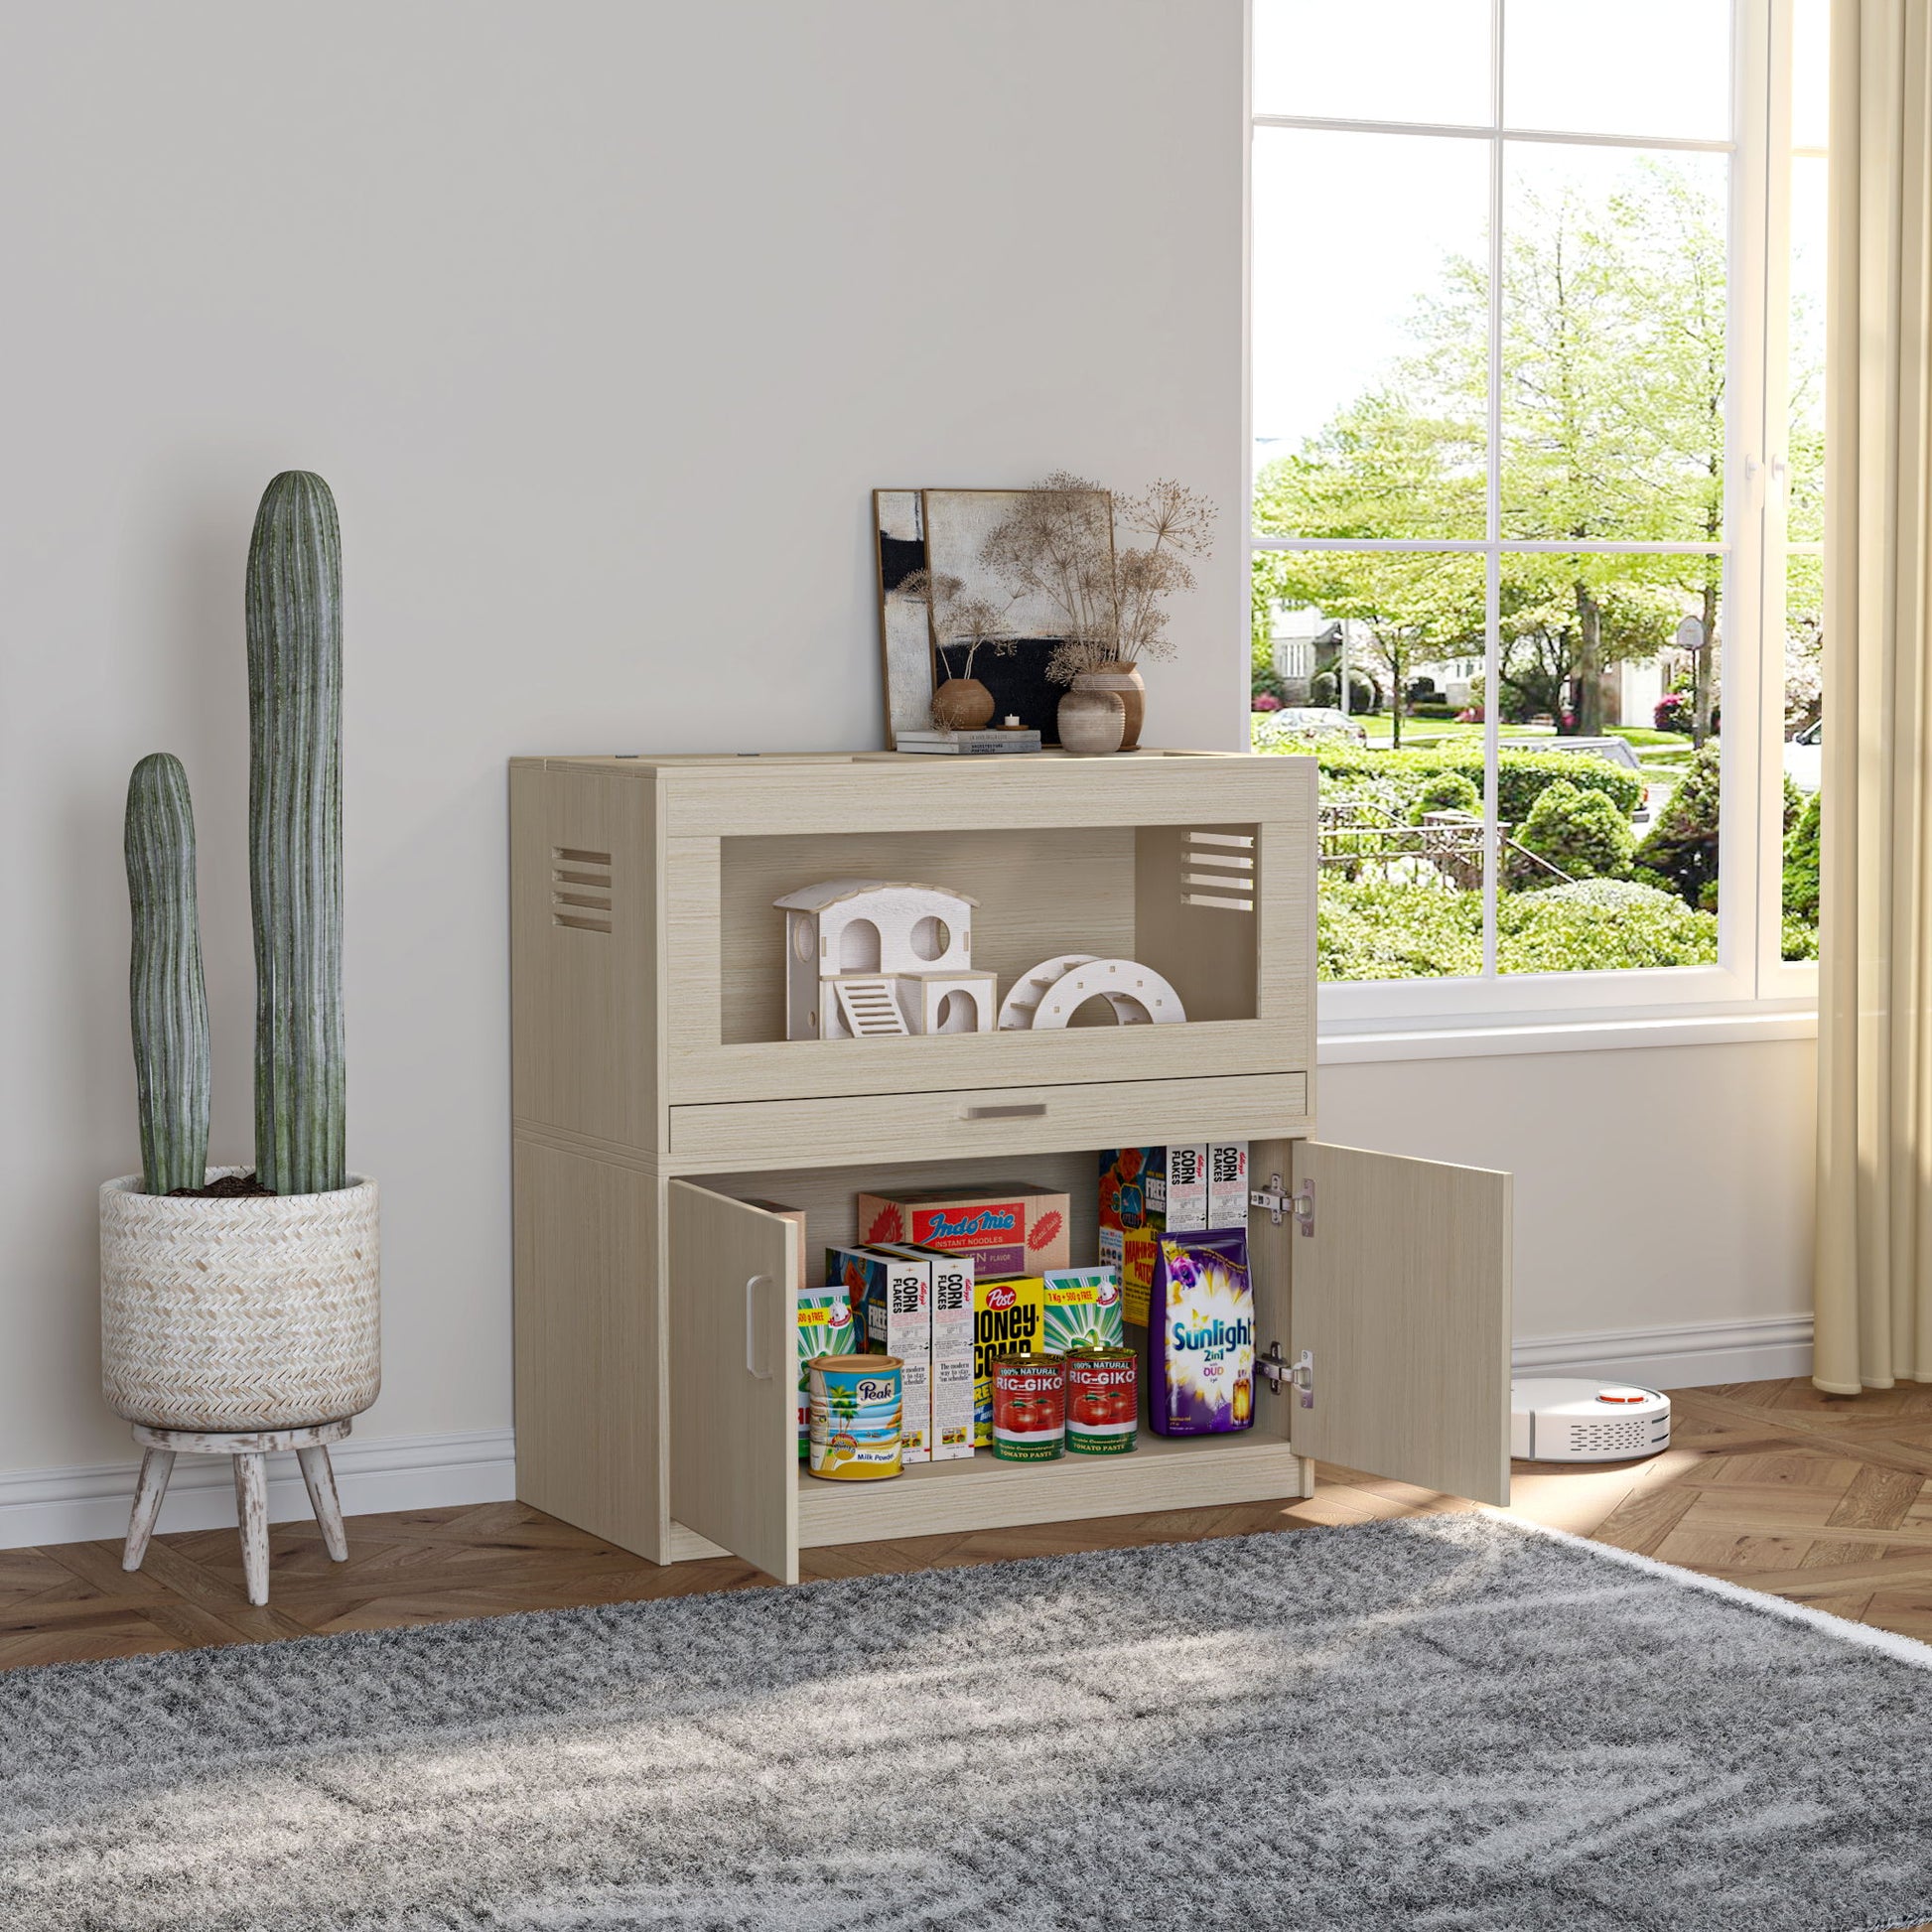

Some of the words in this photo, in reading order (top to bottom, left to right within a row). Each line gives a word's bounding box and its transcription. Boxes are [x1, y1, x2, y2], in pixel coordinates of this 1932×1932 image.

[1172, 1151, 1180, 1185] FLAKES
[1181, 1150, 1195, 1184] CORN
[1213, 1148, 1222, 1182] FLAKES
[1223, 1147, 1237, 1181] CORN
[935, 1238, 966, 1248] INSTANT
[968, 1236, 1003, 1247] NOODLES
[893, 1278, 902, 1313] FLAKES
[902, 1277, 917, 1313] CORN
[937, 1275, 946, 1311] FLAKES
[947, 1274, 963, 1310] CORN
[989, 1288, 1015, 1308] Post
[1048, 1293, 1052, 1302] 1
[1052, 1294, 1061, 1303] Kg
[1065, 1292, 1076, 1302] 500
[1081, 1291, 1092, 1301] FREE
[811, 1311, 824, 1321] FREE
[1172, 1317, 1251, 1352] Sunlight
[1203, 1348, 1224, 1362] 2in1
[996, 1376, 1063, 1391] RIC-GIKO
[1069, 1370, 1135, 1385] RIC-GIKO
[1203, 1366, 1224, 1377] OUD
[859, 1381, 892, 1402] Peak
